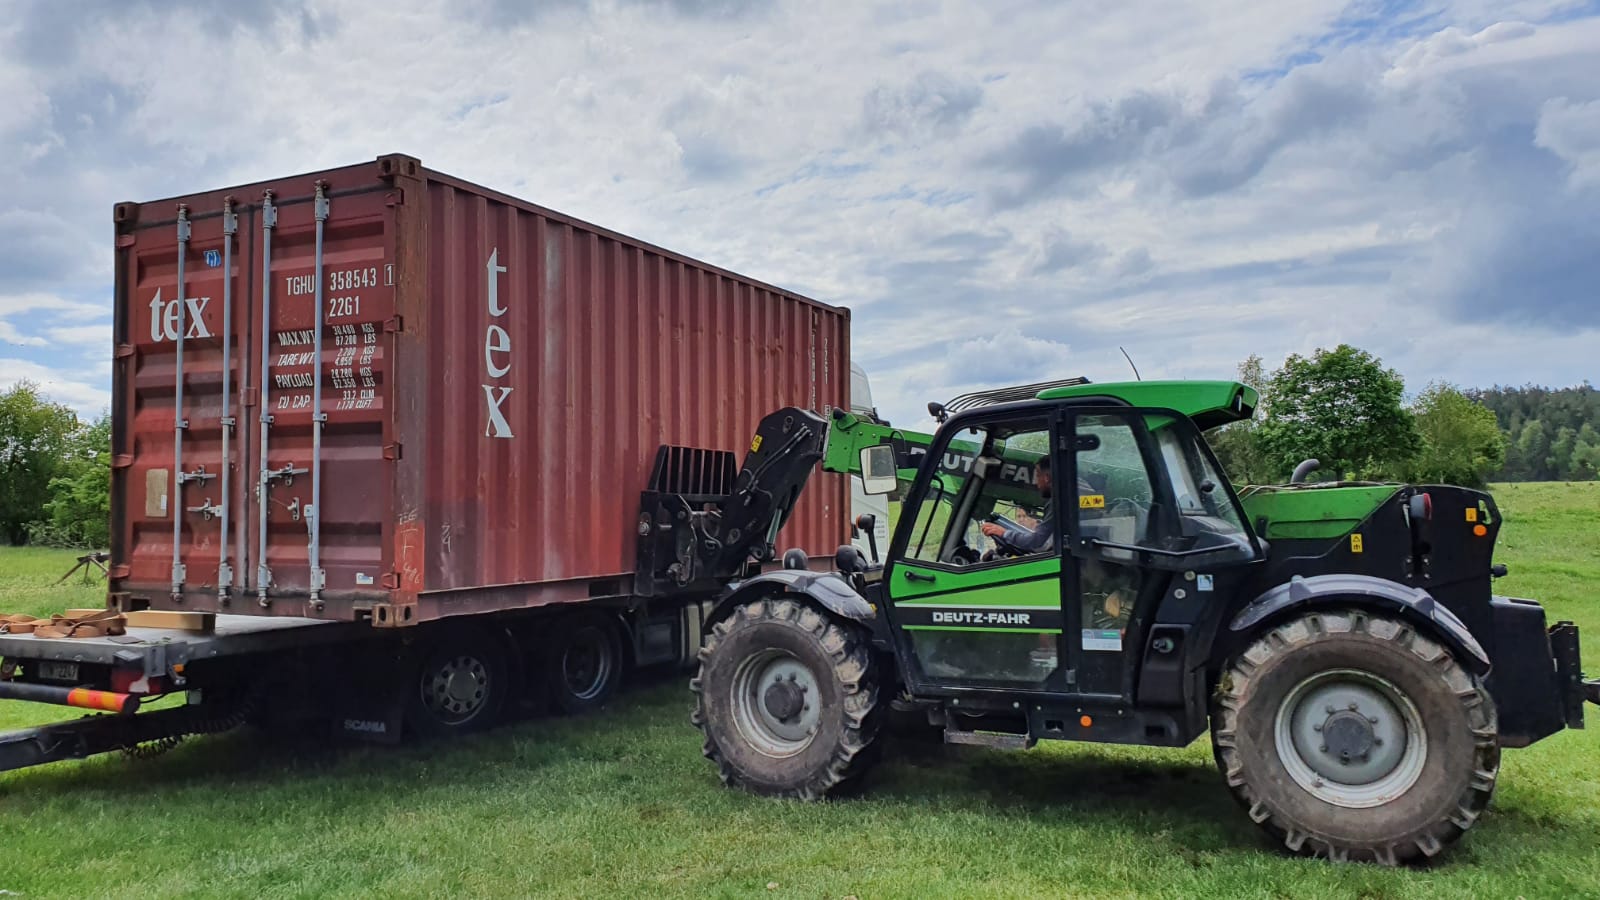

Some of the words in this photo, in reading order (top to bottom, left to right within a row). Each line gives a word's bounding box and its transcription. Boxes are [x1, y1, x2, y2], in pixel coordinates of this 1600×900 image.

[286, 275, 315, 296] TGHU
[329, 268, 376, 291] 358543
[329, 296, 360, 317] 22G1
[364, 333, 376, 344] LBS
[482, 246, 514, 438] tex
[277, 354, 299, 367] TARE
[360, 355, 372, 365] LBS
[275, 373, 314, 388] PAYLOAD
[362, 377, 376, 387] LBS
[278, 395, 290, 409] CU
[932, 611, 1031, 625] DEUTZ-FAHR
